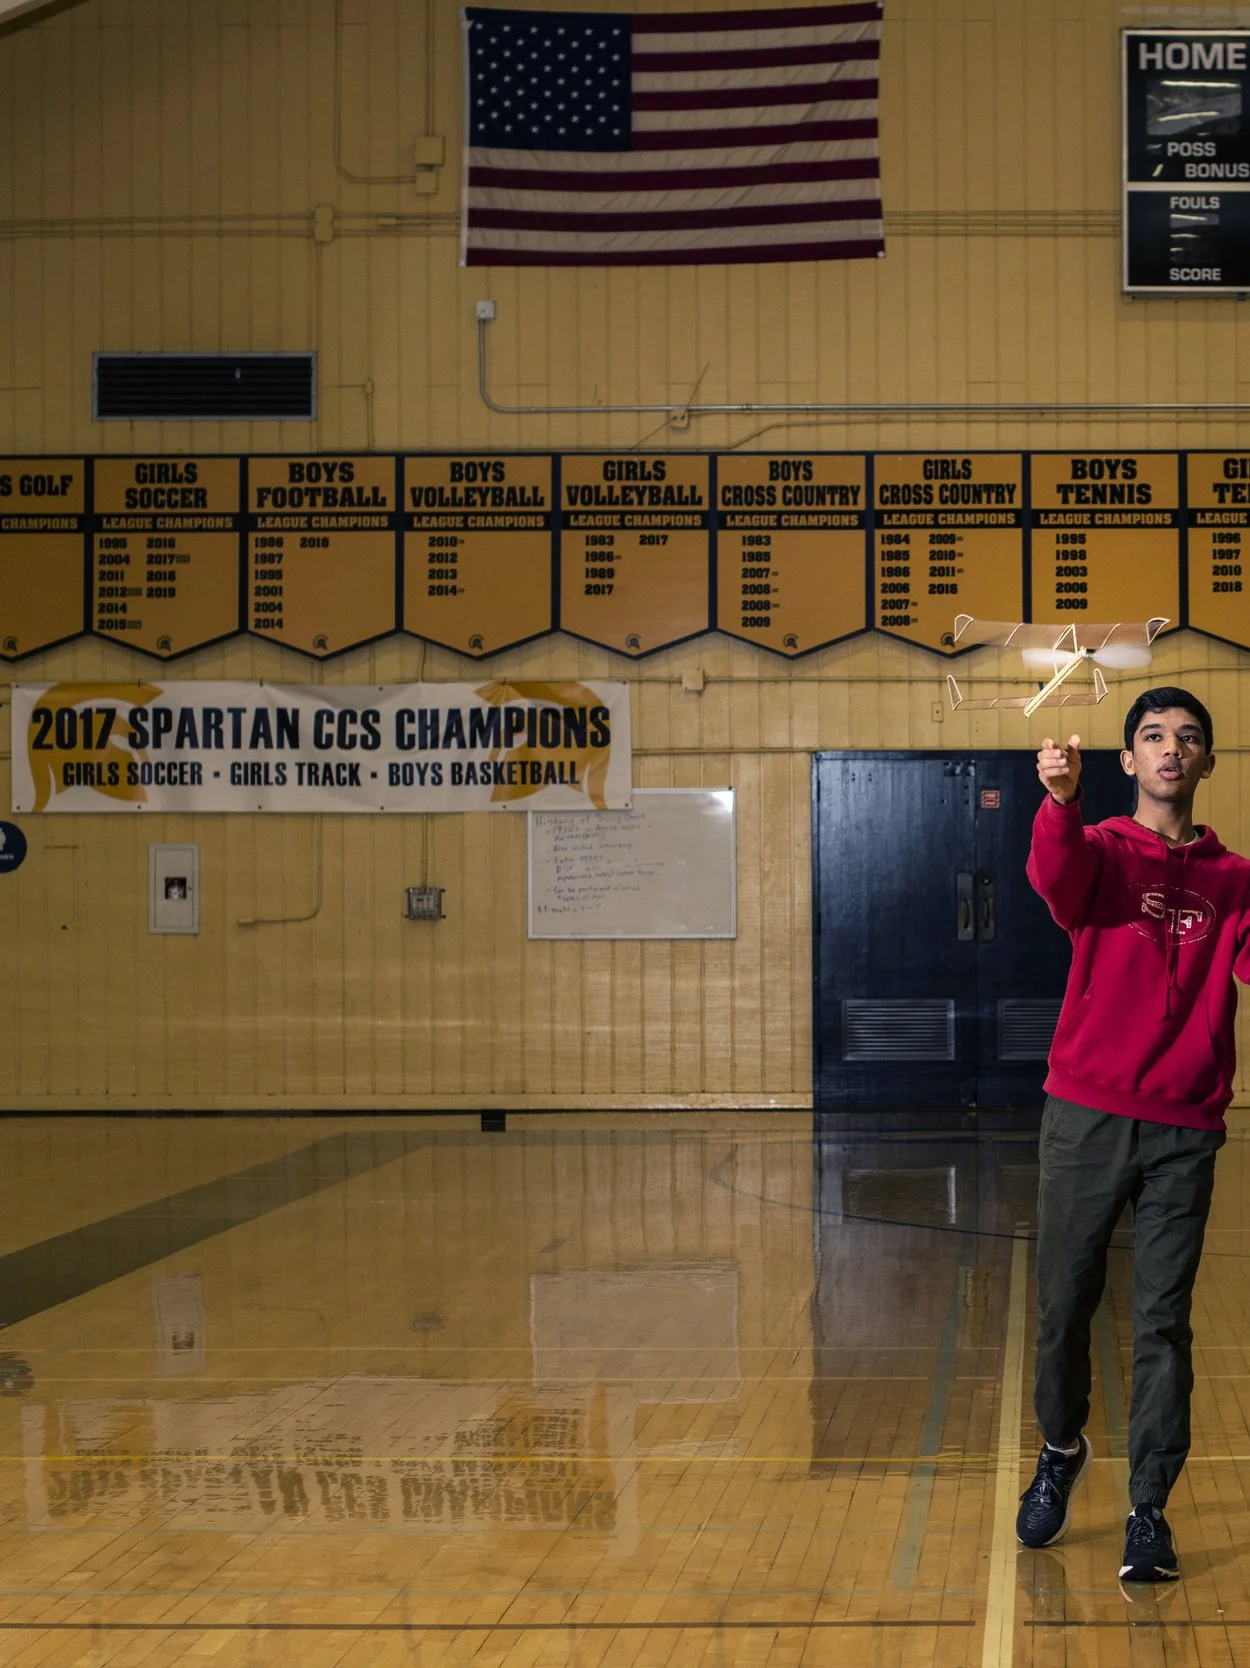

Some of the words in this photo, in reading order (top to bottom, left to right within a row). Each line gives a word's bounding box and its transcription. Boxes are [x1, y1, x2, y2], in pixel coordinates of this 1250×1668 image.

[1139, 42, 1247, 70] HOME
[1167, 142, 1216, 157] POSS
[1185, 163, 1250, 178] BONUS
[1170, 196, 1220, 209] FOULS
[1169, 268, 1221, 281] SCORE
[135, 462, 198, 485] GIRLS
[288, 462, 354, 483] BOYS
[450, 461, 505, 483] BOYS
[602, 460, 666, 481] GIRLS
[768, 460, 813, 481] BOYS
[923, 459, 972, 480] GIRLS
[1071, 459, 1137, 480] BOYS
[20, 475, 73, 496] GOLF
[125, 487, 208, 509] SOCCER
[256, 487, 387, 508] FOOTBALL
[410, 486, 545, 508] VOLLEYBALL
[566, 485, 703, 506] VOLLEYBALL
[721, 485, 777, 506] CROSS
[782, 485, 861, 506] COUNTRY
[879, 484, 934, 505] CROSS
[939, 483, 1016, 505] COUNTRY
[1056, 483, 1152, 505] TENNIS
[1, 517, 78, 529] CHAMPIONS
[102, 517, 153, 529] LEAGUE
[156, 517, 233, 529] CHAMPIONS
[257, 516, 308, 528] LEAGUE
[311, 516, 389, 528] CHAMPIONS
[412, 516, 464, 528] LEAGUE
[467, 516, 545, 528] CHAMPIONS
[569, 514, 620, 526] LEAGUE
[624, 514, 702, 526] CHAMPIONS
[726, 514, 778, 527] LEAGUE
[781, 514, 859, 527] CHAMPIONS
[883, 513, 935, 525] LEAGUE
[938, 513, 1016, 525] CHAMPIONS
[1039, 513, 1091, 525] LEAGUE
[1094, 513, 1173, 525] CHAMPIONS
[1196, 512, 1248, 524] LEAGUE
[639, 534, 669, 545] 2017
[98, 554, 130, 565] 2004
[428, 552, 458, 564] 2012
[1212, 549, 1241, 560] 1997
[428, 568, 458, 580] 2013
[1212, 565, 1242, 576] 2010
[584, 584, 614, 595] 2017
[928, 583, 958, 595] 2016
[1212, 581, 1242, 593] 2018
[31, 707, 117, 750] 2017
[128, 707, 299, 750] SPARTAN
[313, 707, 380, 750] CCS
[395, 706, 611, 750] CHAMPIONS
[63, 762, 119, 786] GIRLS
[126, 762, 202, 786] SOCCER
[230, 762, 287, 786] GIRLS
[295, 763, 361, 786] TRACK
[388, 762, 443, 786] BOYS
[451, 761, 580, 785] BASKETBALL
[1141, 892, 1203, 935] SF
